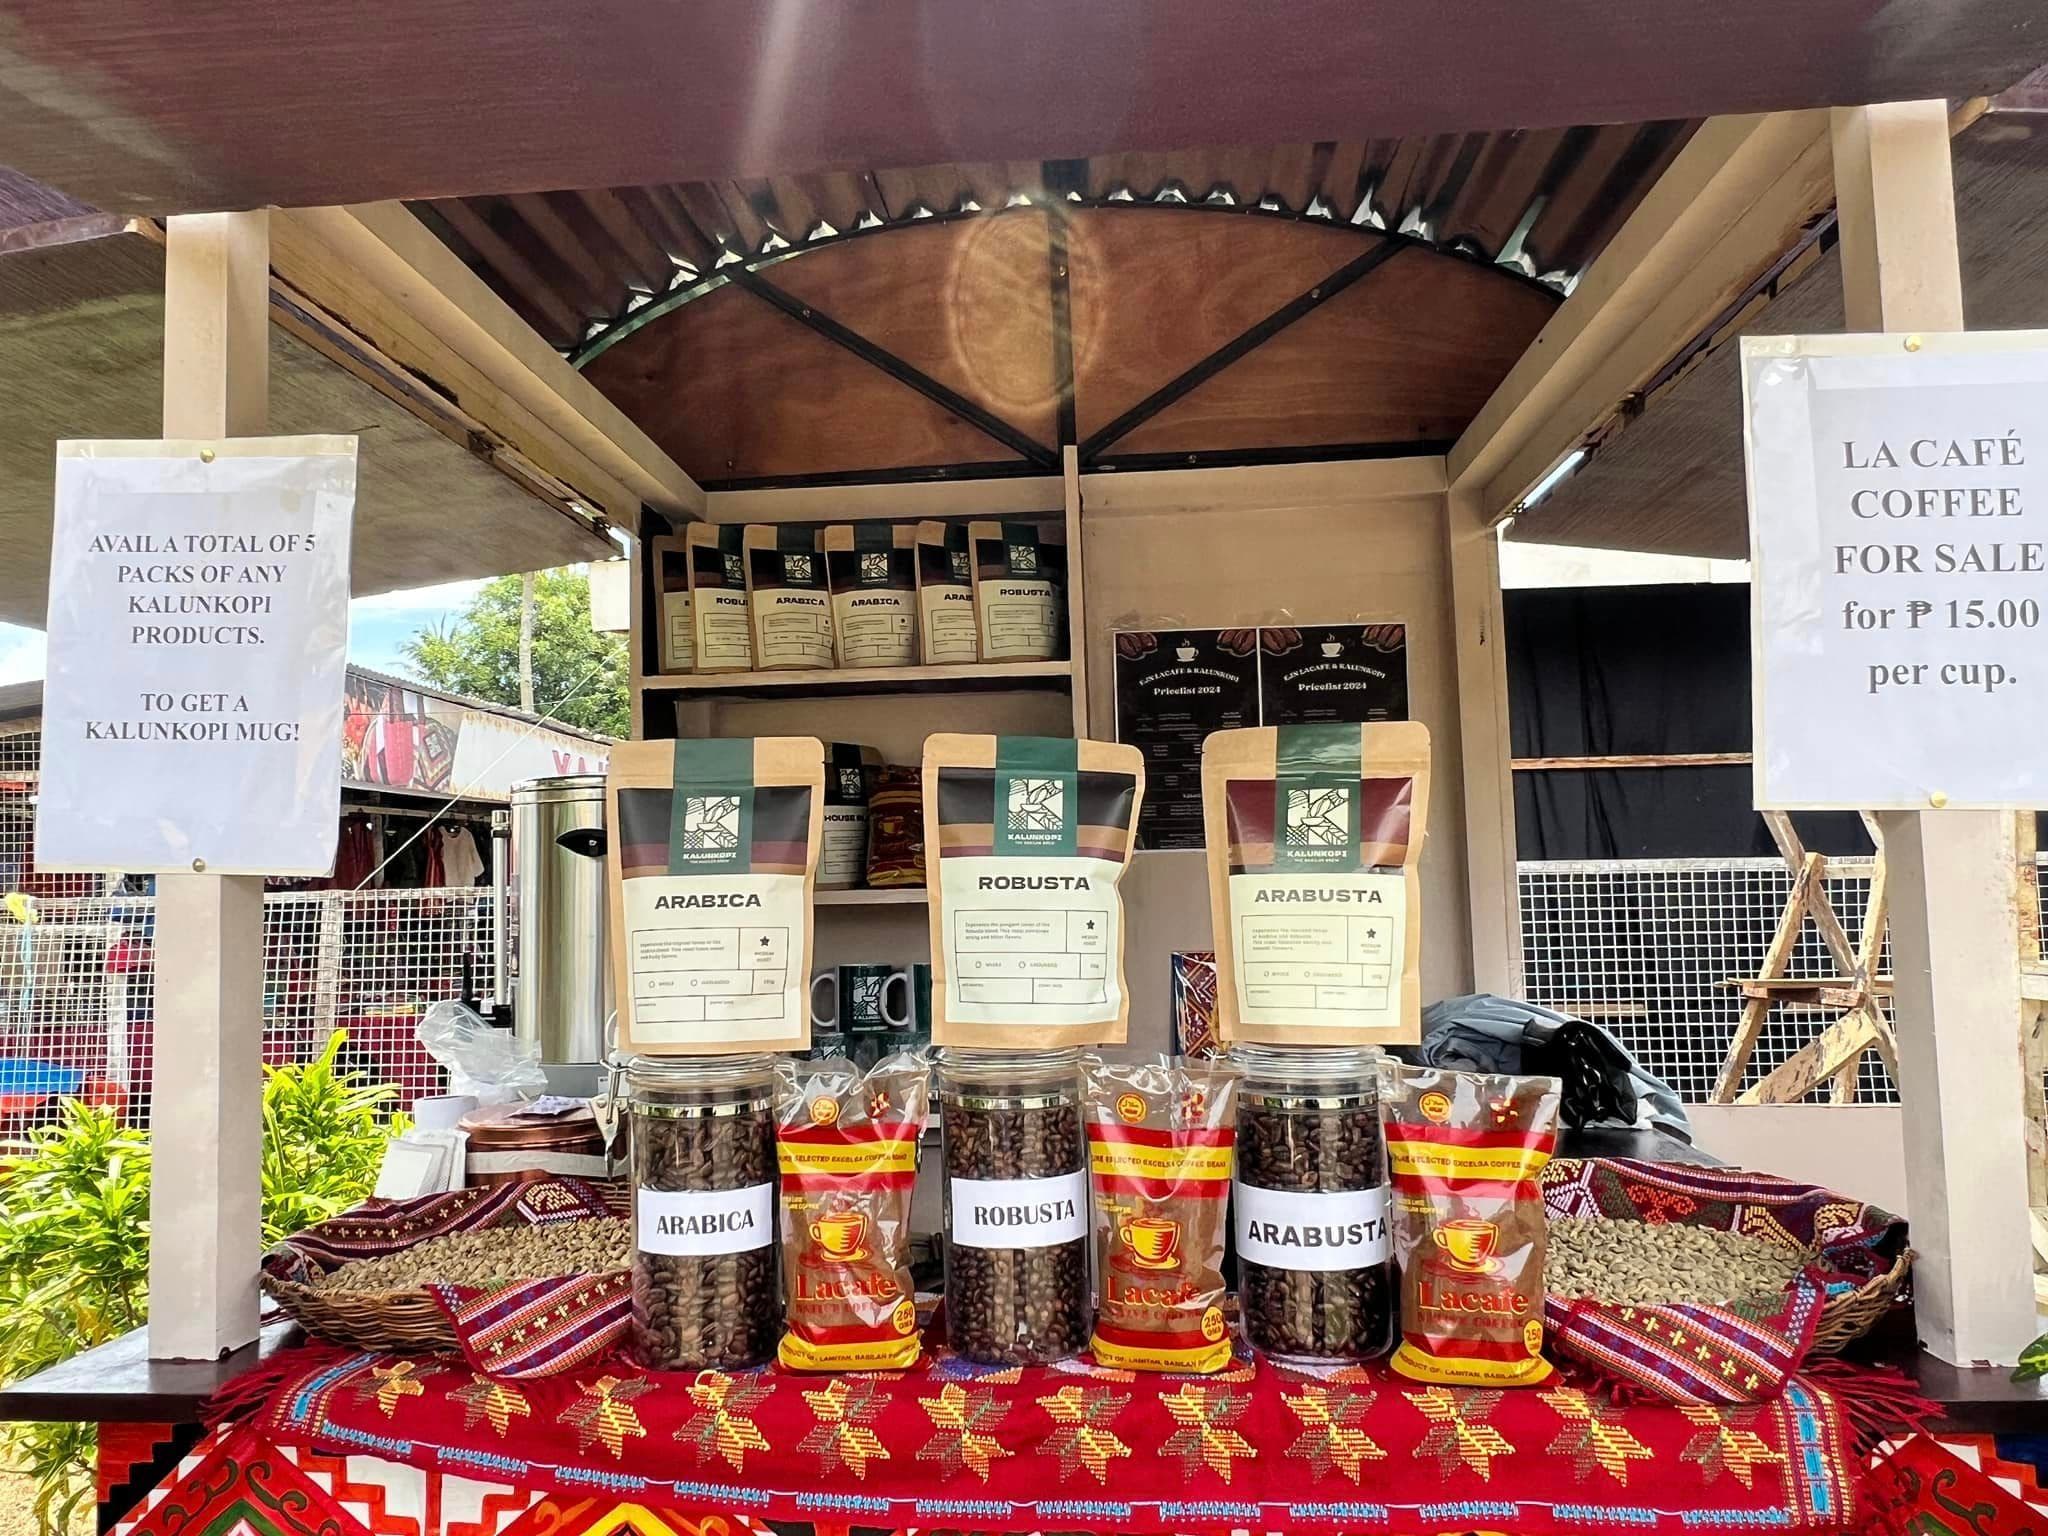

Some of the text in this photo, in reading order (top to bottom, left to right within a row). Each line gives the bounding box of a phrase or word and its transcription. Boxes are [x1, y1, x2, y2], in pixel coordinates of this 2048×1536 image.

[1842, 428, 2025, 469] LA CAFÉ
[1851, 488, 2023, 519] COFFEE
[88, 534, 316, 553] AVAIL A TOTAL OF 5
[1834, 543, 2045, 574] FOR SALE
[117, 565, 286, 584] PACKS OF ANY
[128, 595, 271, 614] KALUNKOPI
[1842, 601, 1896, 630] for
[1945, 599, 2040, 629] 15.00
[131, 626, 265, 645] PRODUCTS.
[1298, 682, 1367, 691] Pricelist 2024
[1869, 664, 2017, 694] per cup.
[1153, 687, 1196, 696] Pricelist
[140, 693, 249, 713] TO GET A
[85, 722, 300, 742] KALUNKOPI MUG!
[978, 876, 1090, 891] ROBUSTA
[654, 893, 761, 910] ARABICA
[1254, 889, 1382, 904] ARABUSTA
[656, 1208, 755, 1236] ARABICA
[973, 1199, 1075, 1227] ROBUSTA
[1248, 1220, 1387, 1248] ARABUSTA
[797, 1271, 897, 1301] Lacafe
[1419, 1282, 1529, 1317] Lacafe
[1526, 1328, 1541, 1341] 250
